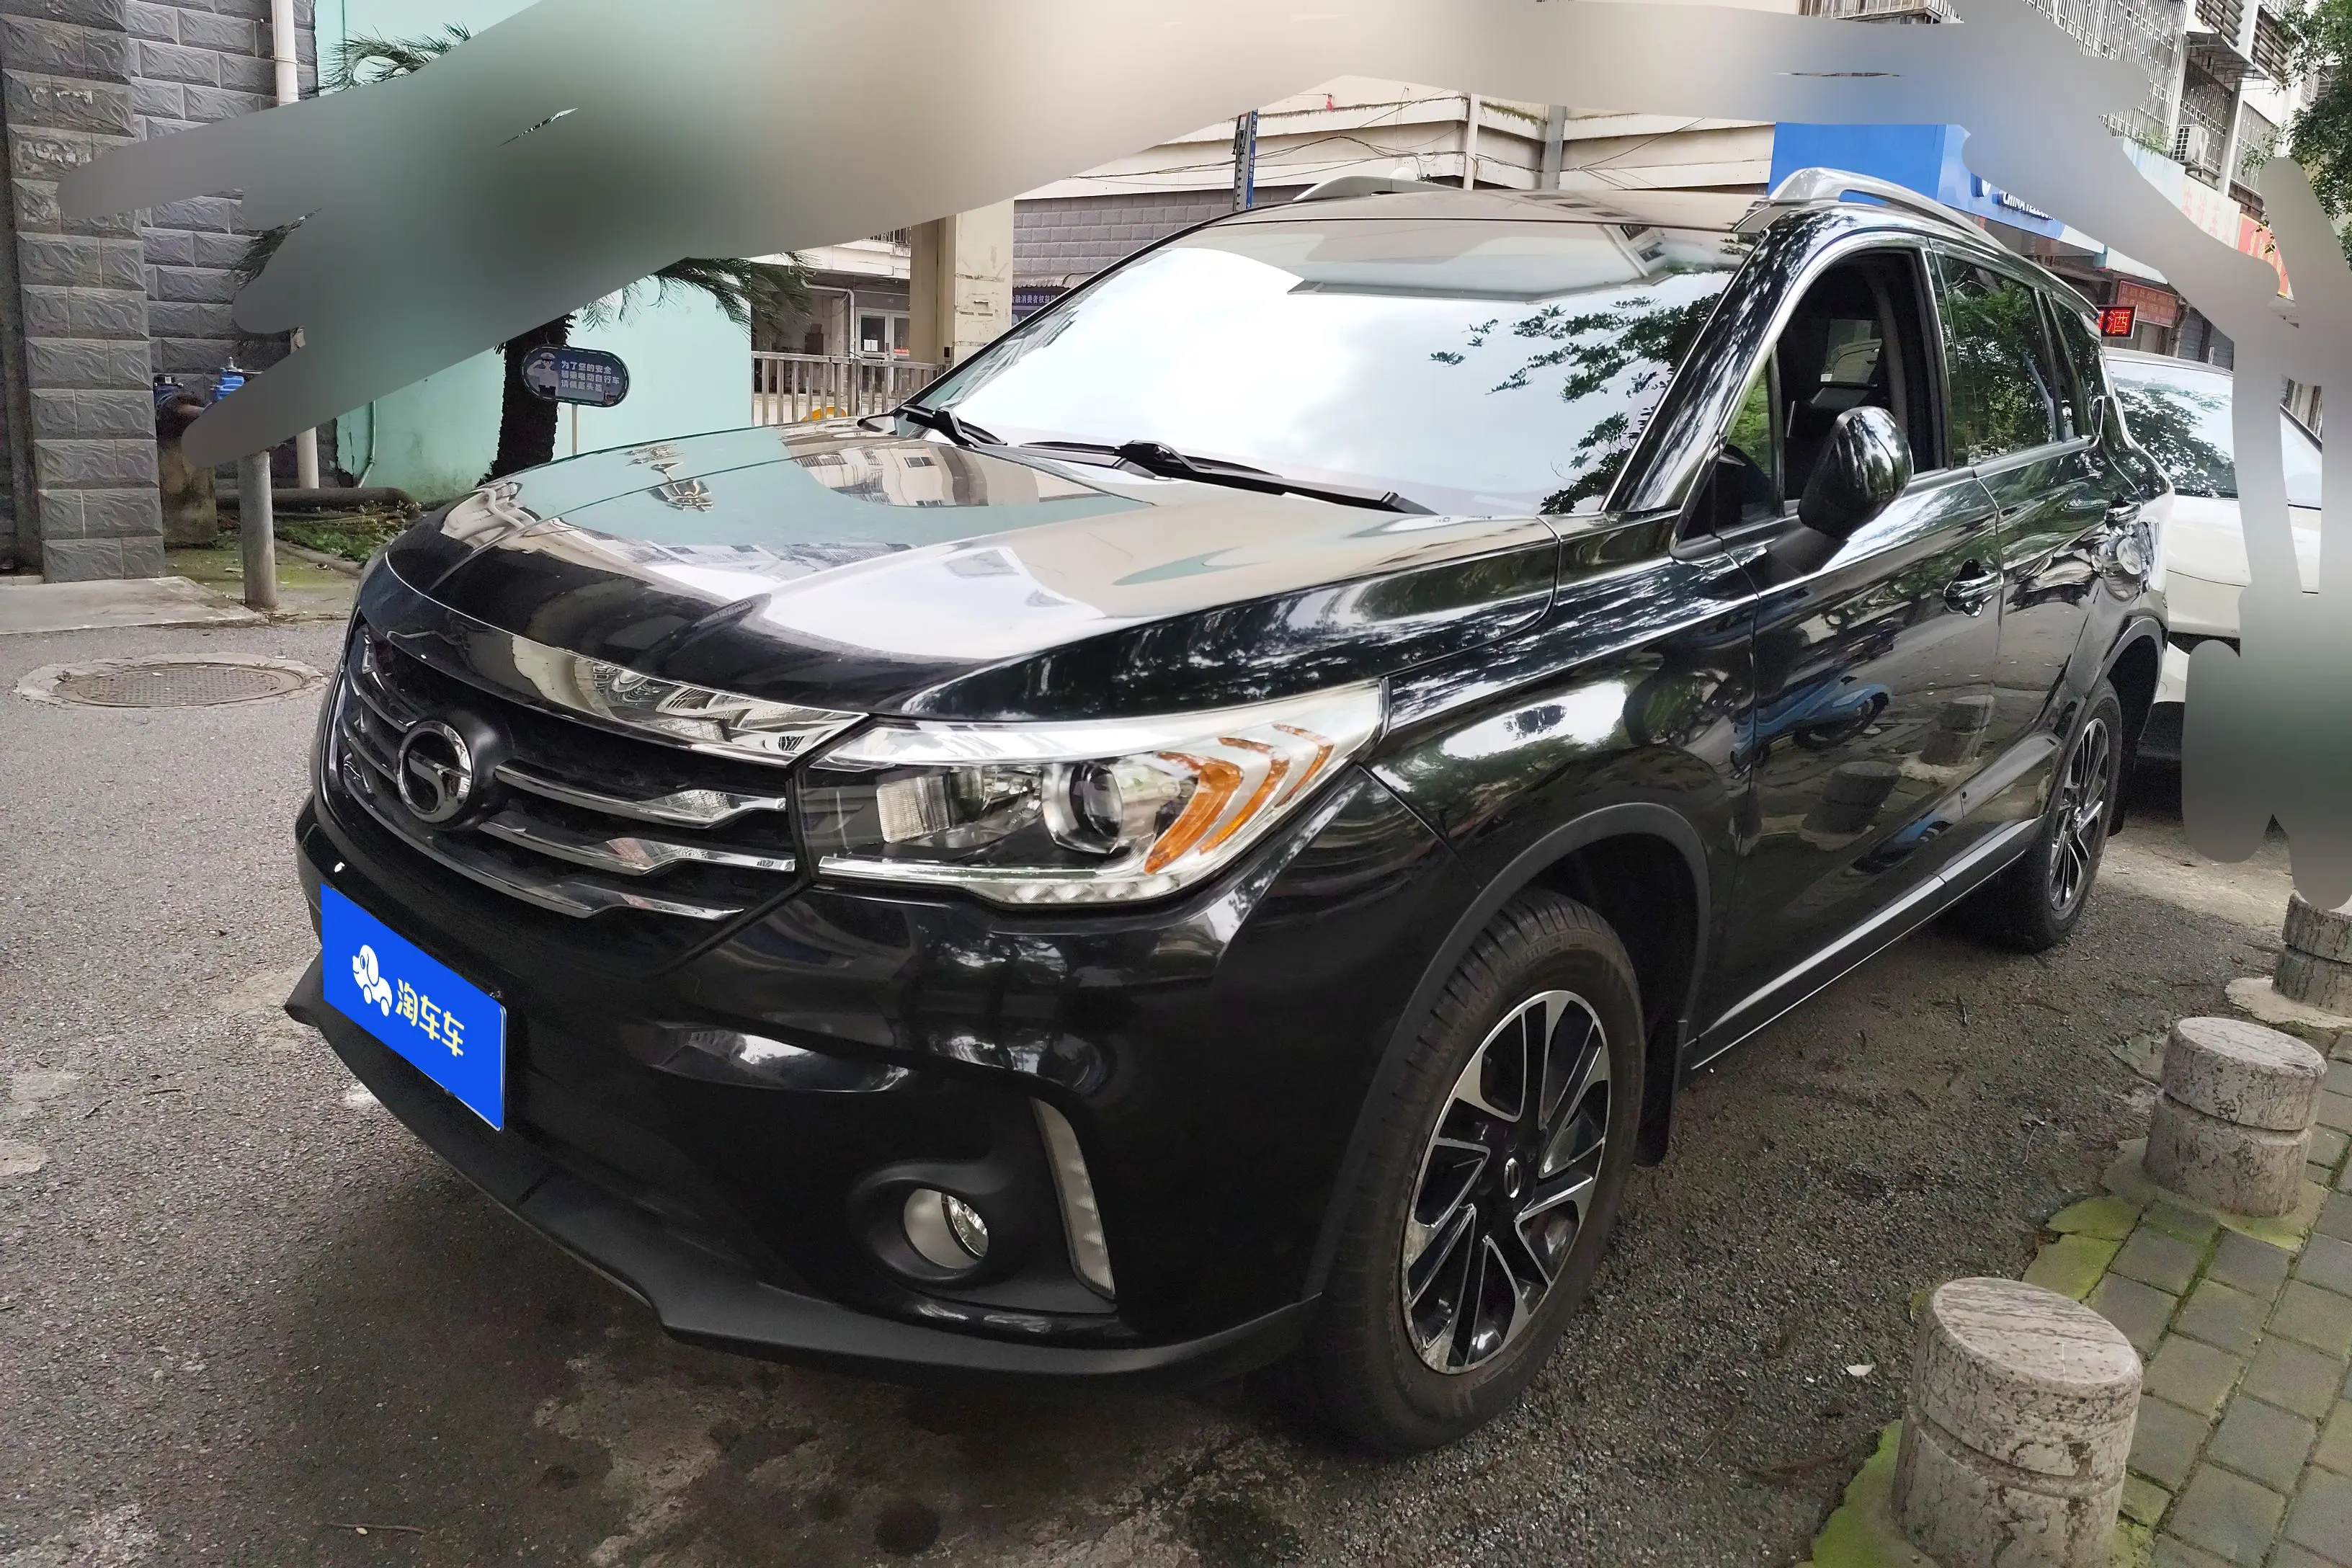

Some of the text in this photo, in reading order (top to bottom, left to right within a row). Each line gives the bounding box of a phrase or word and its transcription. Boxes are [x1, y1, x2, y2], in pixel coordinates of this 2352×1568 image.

[561, 360, 612, 374] 为了您的安全
